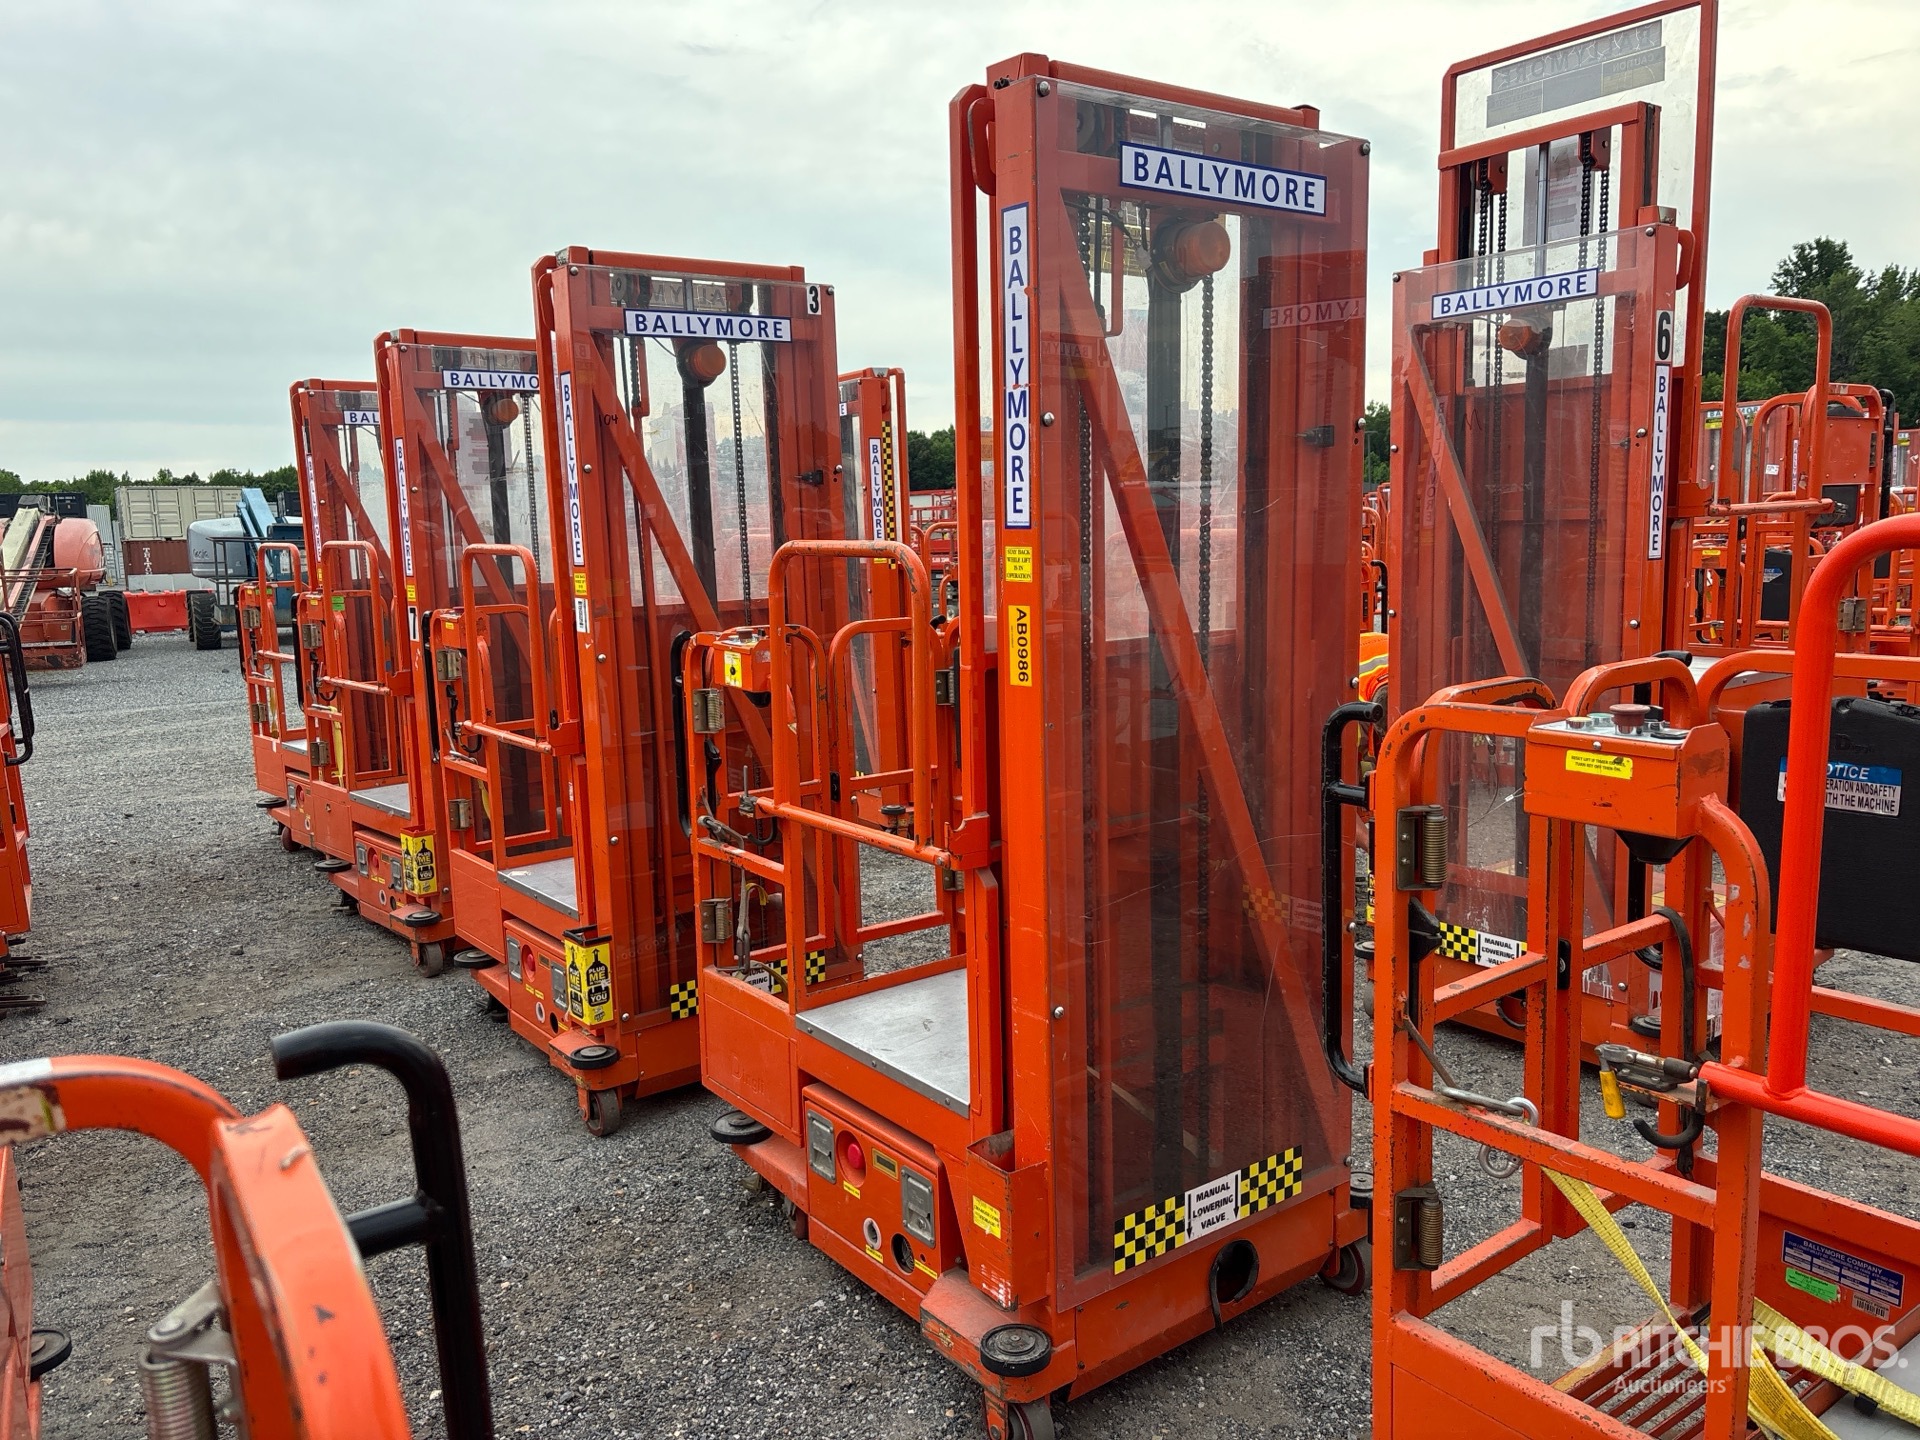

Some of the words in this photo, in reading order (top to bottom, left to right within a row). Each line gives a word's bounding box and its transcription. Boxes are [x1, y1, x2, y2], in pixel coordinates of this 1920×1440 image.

[1133, 151, 1316, 209] BALLYMORE
[809, 285, 819, 314] 3
[1441, 274, 1587, 315] BALLYMORE
[634, 313, 784, 339] BALLYMORE
[1658, 311, 1672, 361] 6
[450, 372, 540, 389] BALLYMO
[1007, 225, 1026, 514] BALLYMORE
[564, 384, 581, 558] BALLYMORE
[1652, 376, 1666, 551] BALLYMORE
[871, 444, 882, 539] BALLYMORE
[397, 446, 412, 571] BALLYMORE
[1016, 607, 1029, 682] AB0986
[1826, 763, 1870, 780] OTICE
[1826, 778, 1854, 793] ERATION
[1826, 792, 1838, 805] ITH
[1840, 794, 1856, 807] THE
[1857, 796, 1895, 812] MACHINE
[1484, 937, 1512, 949] MANUAL
[588, 965, 605, 974] PLUG
[589, 971, 606, 982] ME
[590, 992, 607, 1003] YOU
[1196, 1181, 1231, 1203] MANUAL
[1192, 1194, 1234, 1219] LOWERING
[1200, 1212, 1226, 1230] VALVE
[1803, 1240, 1846, 1260] BALLYMORE
[1846, 1257, 1883, 1274] COMPANY
